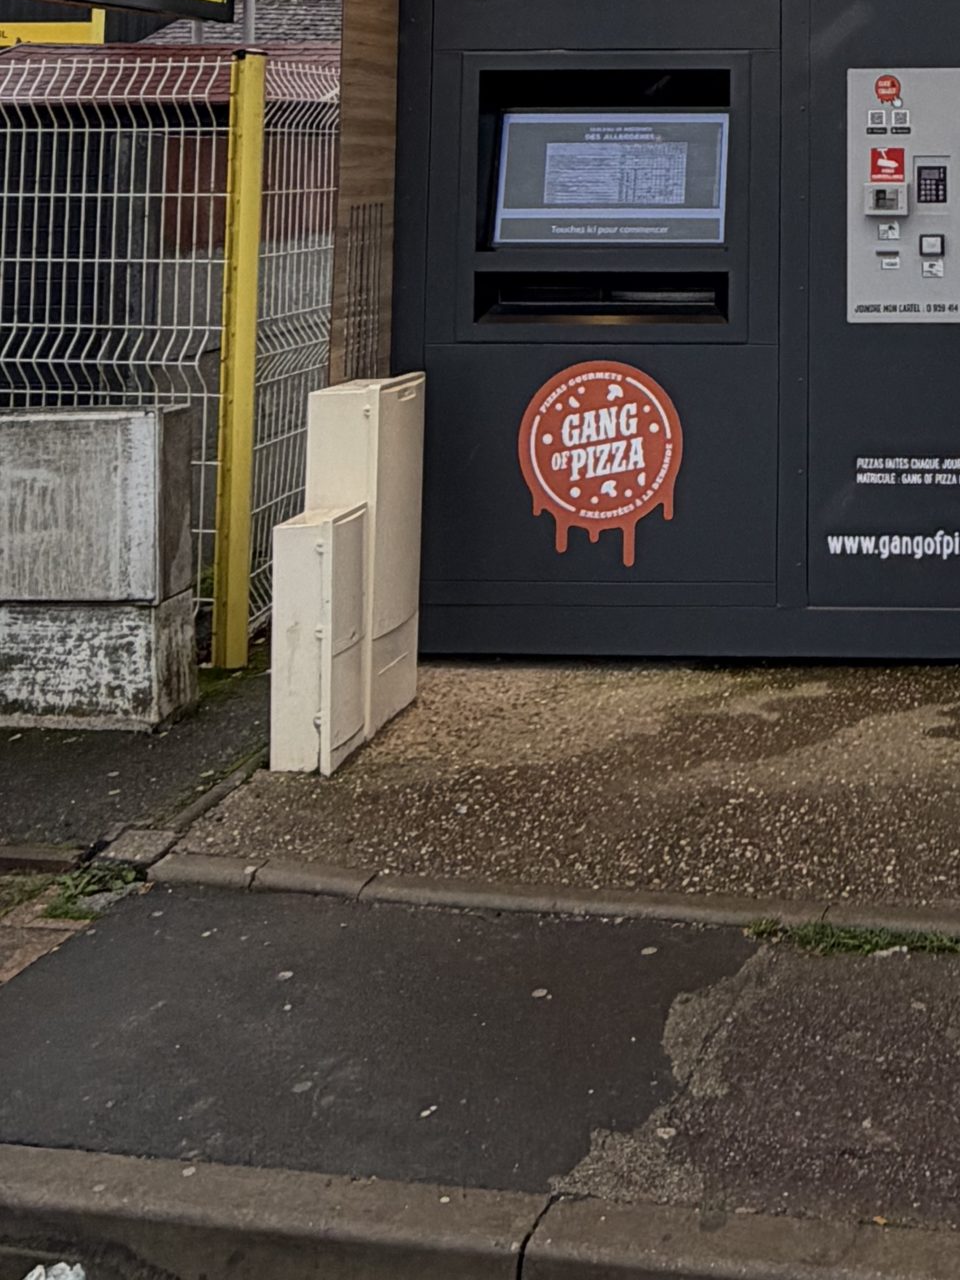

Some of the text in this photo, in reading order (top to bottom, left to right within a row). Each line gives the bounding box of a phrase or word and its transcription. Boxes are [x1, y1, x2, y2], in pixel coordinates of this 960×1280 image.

[597, 226, 618, 236] pour
[883, 304, 897, 313] MON
[561, 402, 638, 447] GANG
[551, 437, 645, 481] OF PIZZA
[856, 458, 883, 469] PIZZAS
[856, 473, 896, 484] MATRICULE
[901, 474, 922, 484] GANG
[924, 474, 933, 484] OF
[935, 474, 957, 485] PIZZA
